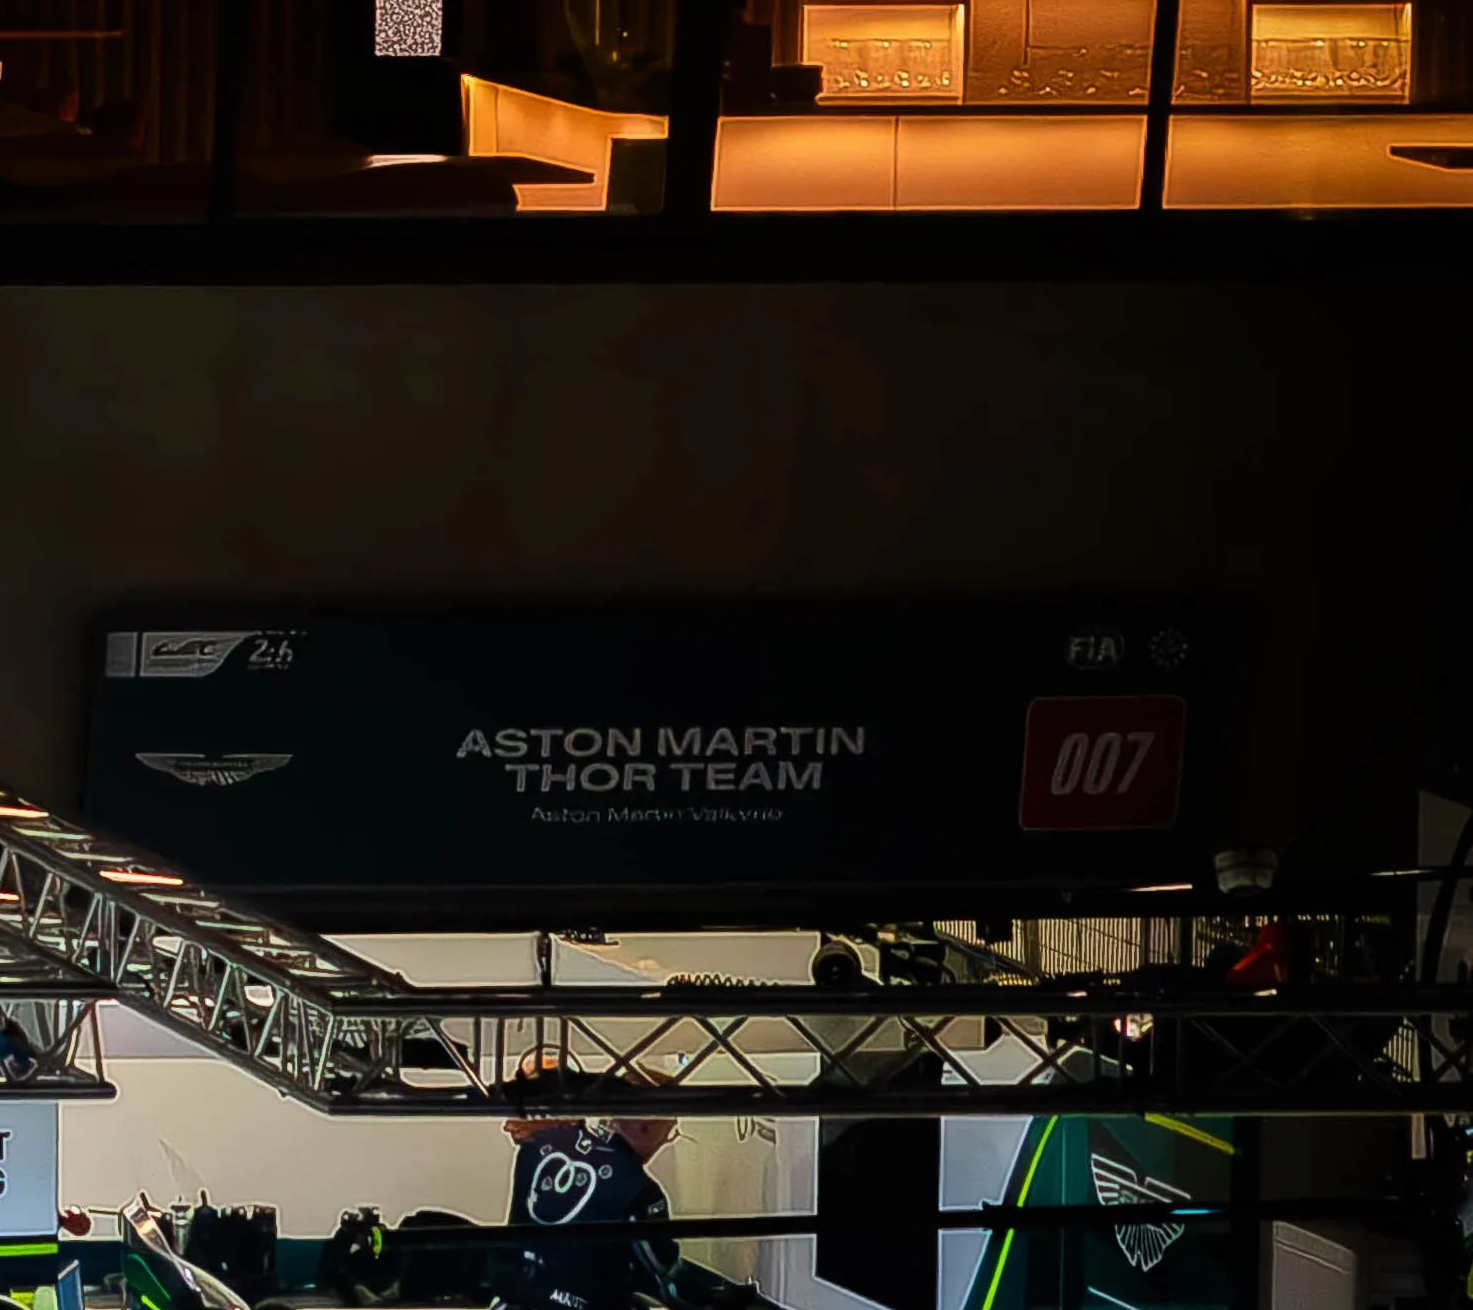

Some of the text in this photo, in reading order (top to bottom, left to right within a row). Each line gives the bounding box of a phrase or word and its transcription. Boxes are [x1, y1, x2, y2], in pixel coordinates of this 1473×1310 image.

[457, 726, 866, 758] ASTON MARTIN
[505, 761, 822, 792] THOR TEAM
[1049, 731, 1157, 797] 007
